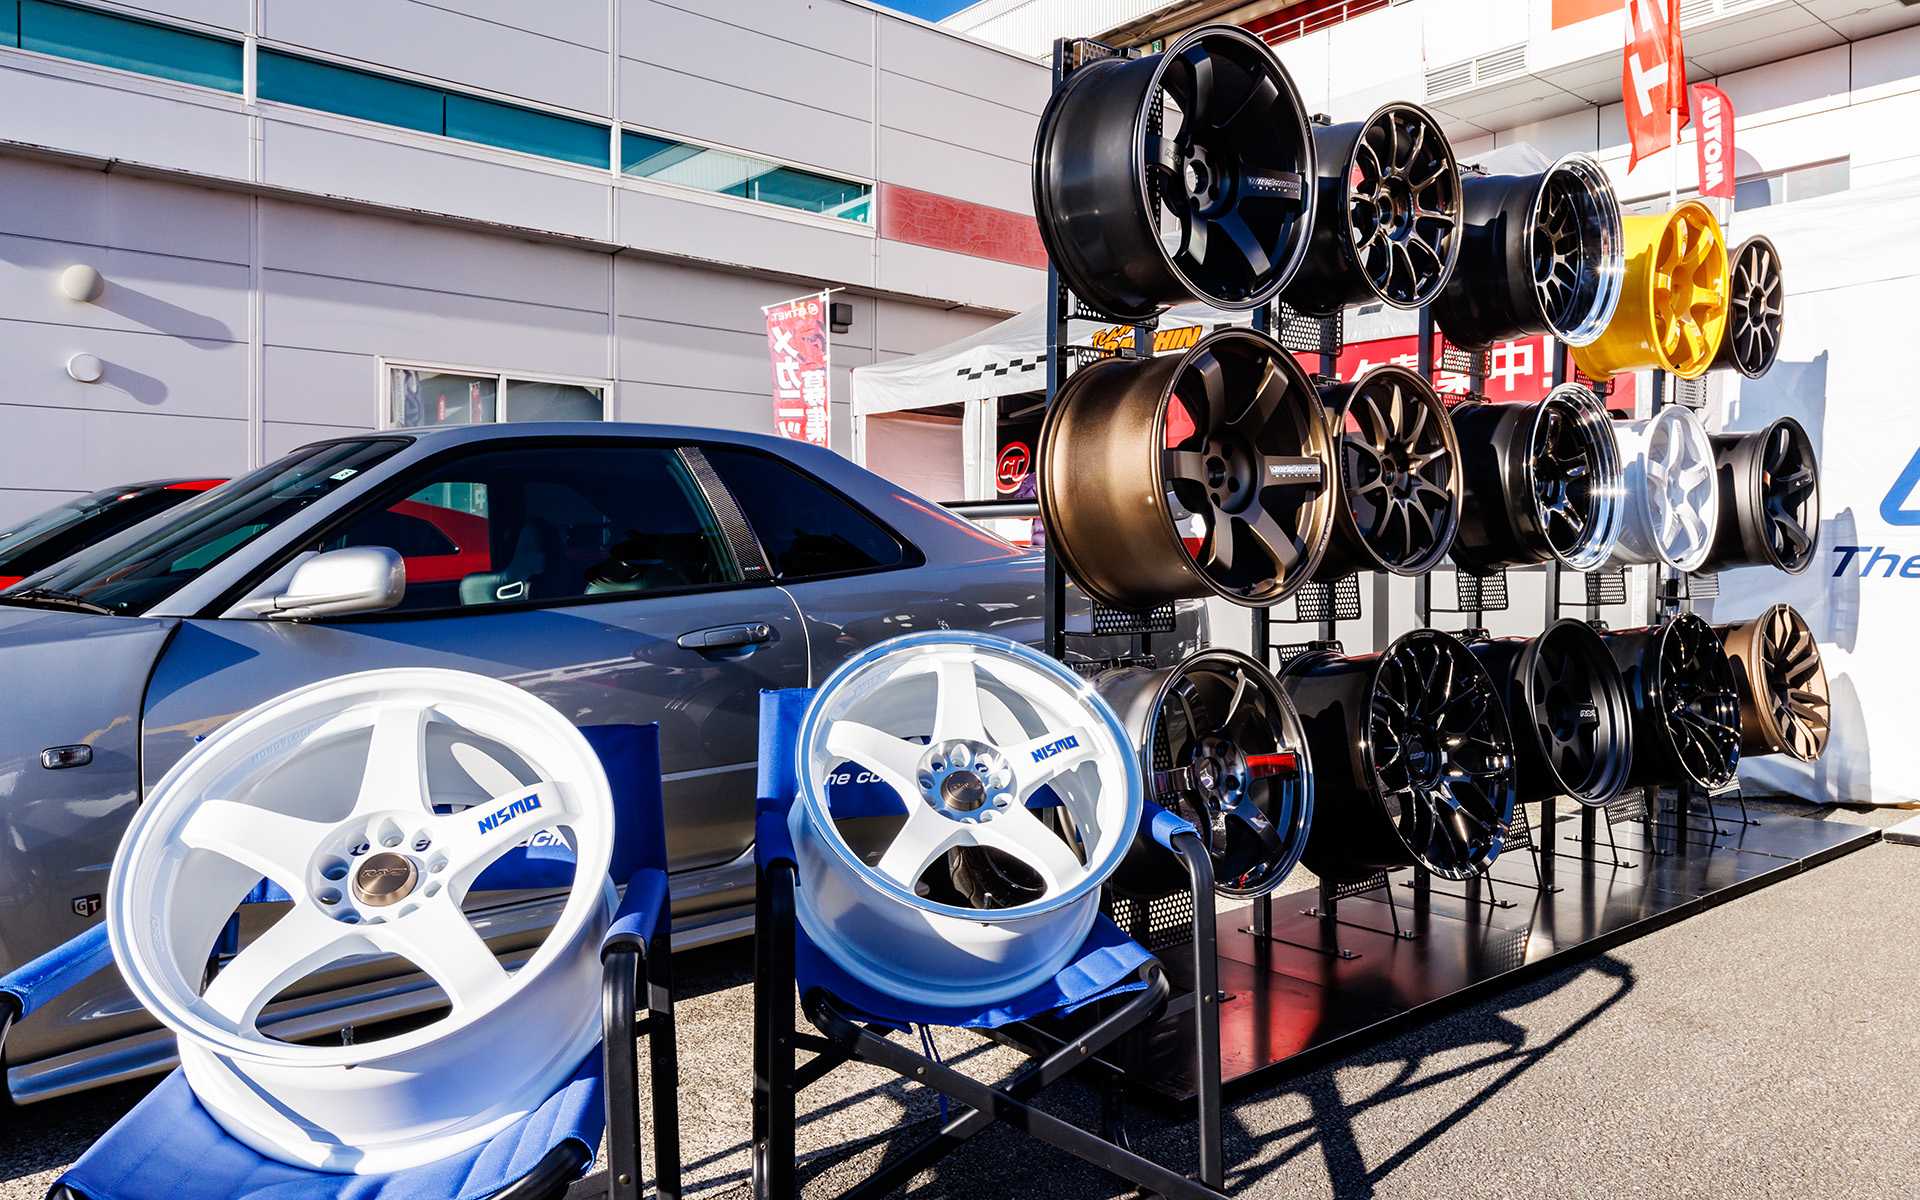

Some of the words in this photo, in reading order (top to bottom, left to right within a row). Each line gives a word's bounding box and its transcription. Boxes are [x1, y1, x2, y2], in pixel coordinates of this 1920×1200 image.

[1832, 546, 1920, 578] The
[1030, 735, 1080, 763] NISMO
[477, 793, 542, 835] NISMO
